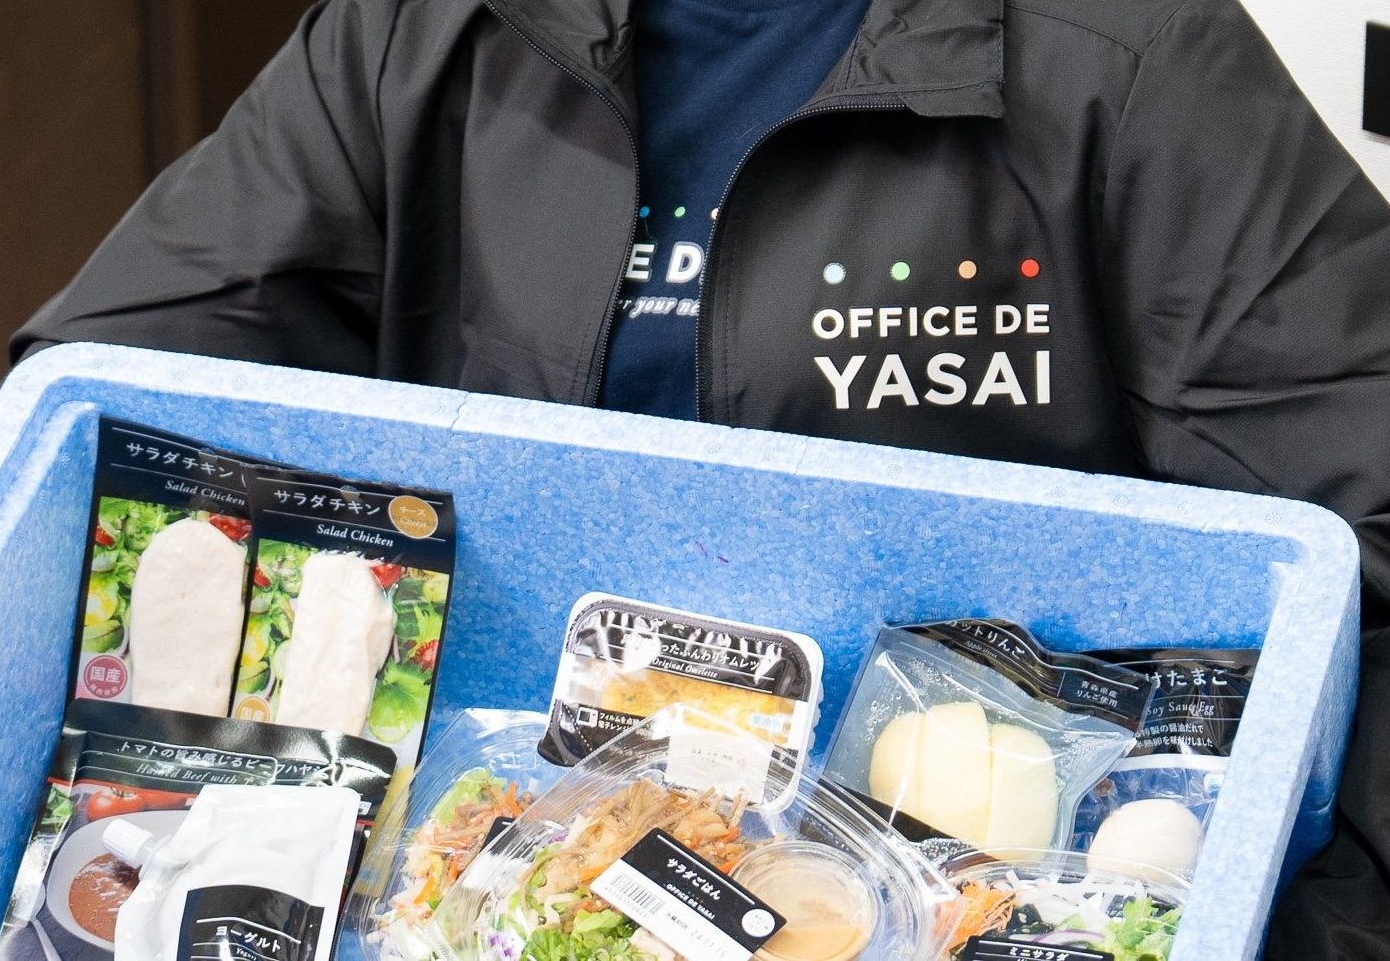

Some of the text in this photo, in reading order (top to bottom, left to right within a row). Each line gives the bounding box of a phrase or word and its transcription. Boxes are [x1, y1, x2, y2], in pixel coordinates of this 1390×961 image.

[630, 298, 676, 317] your
[812, 303, 1051, 340] OFFICE DE
[813, 349, 1051, 410] YASAI
[125, 441, 234, 478] サラダチキン
[164, 479, 247, 506] Salad Chicken
[273, 488, 381, 516] サラダチキン
[316, 523, 394, 548] Salad Chicken
[652, 657, 719, 679] Original Omelette
[657, 642, 761, 671] ったふんわりオムレツ
[90, 665, 122, 683] 国産
[1076, 689, 1119, 708] りんご使用
[1081, 680, 1119, 699] 青森県産
[1146, 705, 1164, 717] Soy
[1198, 701, 1215, 715] Egg
[183, 769, 209, 783] Beef
[210, 773, 237, 786] with
[666, 857, 721, 901] サラダごはん
[666, 883, 689, 902] OFFICE
[688, 898, 699, 908] DE
[696, 904, 716, 920] YASAI
[215, 925, 281, 953] ヨーグルト
[1009, 946, 1071, 961] ミニサラダ
